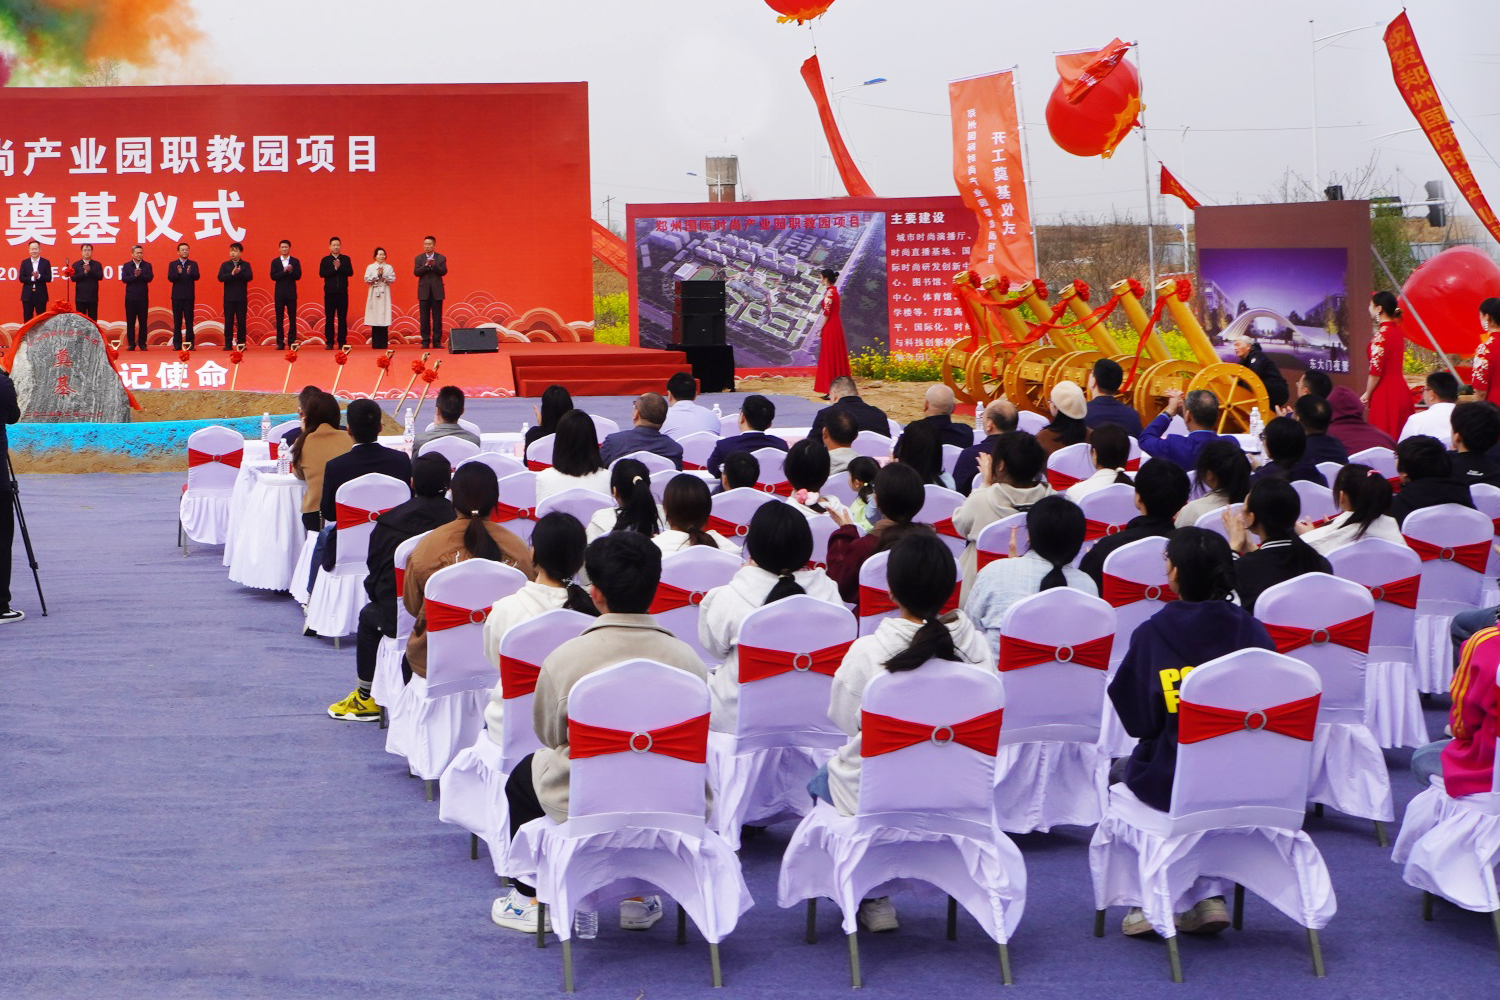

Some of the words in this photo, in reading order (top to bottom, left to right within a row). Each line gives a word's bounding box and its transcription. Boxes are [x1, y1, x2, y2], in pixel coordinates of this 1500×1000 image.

[655, 215, 861, 233] 郑州国际时尚产业园职教园项目
[891, 212, 945, 225] 主要建设
[892, 277, 956, 287] 心、图书馆、
[52, 348, 77, 396] 奠基
[1308, 358, 1349, 372] 东大门夜景
